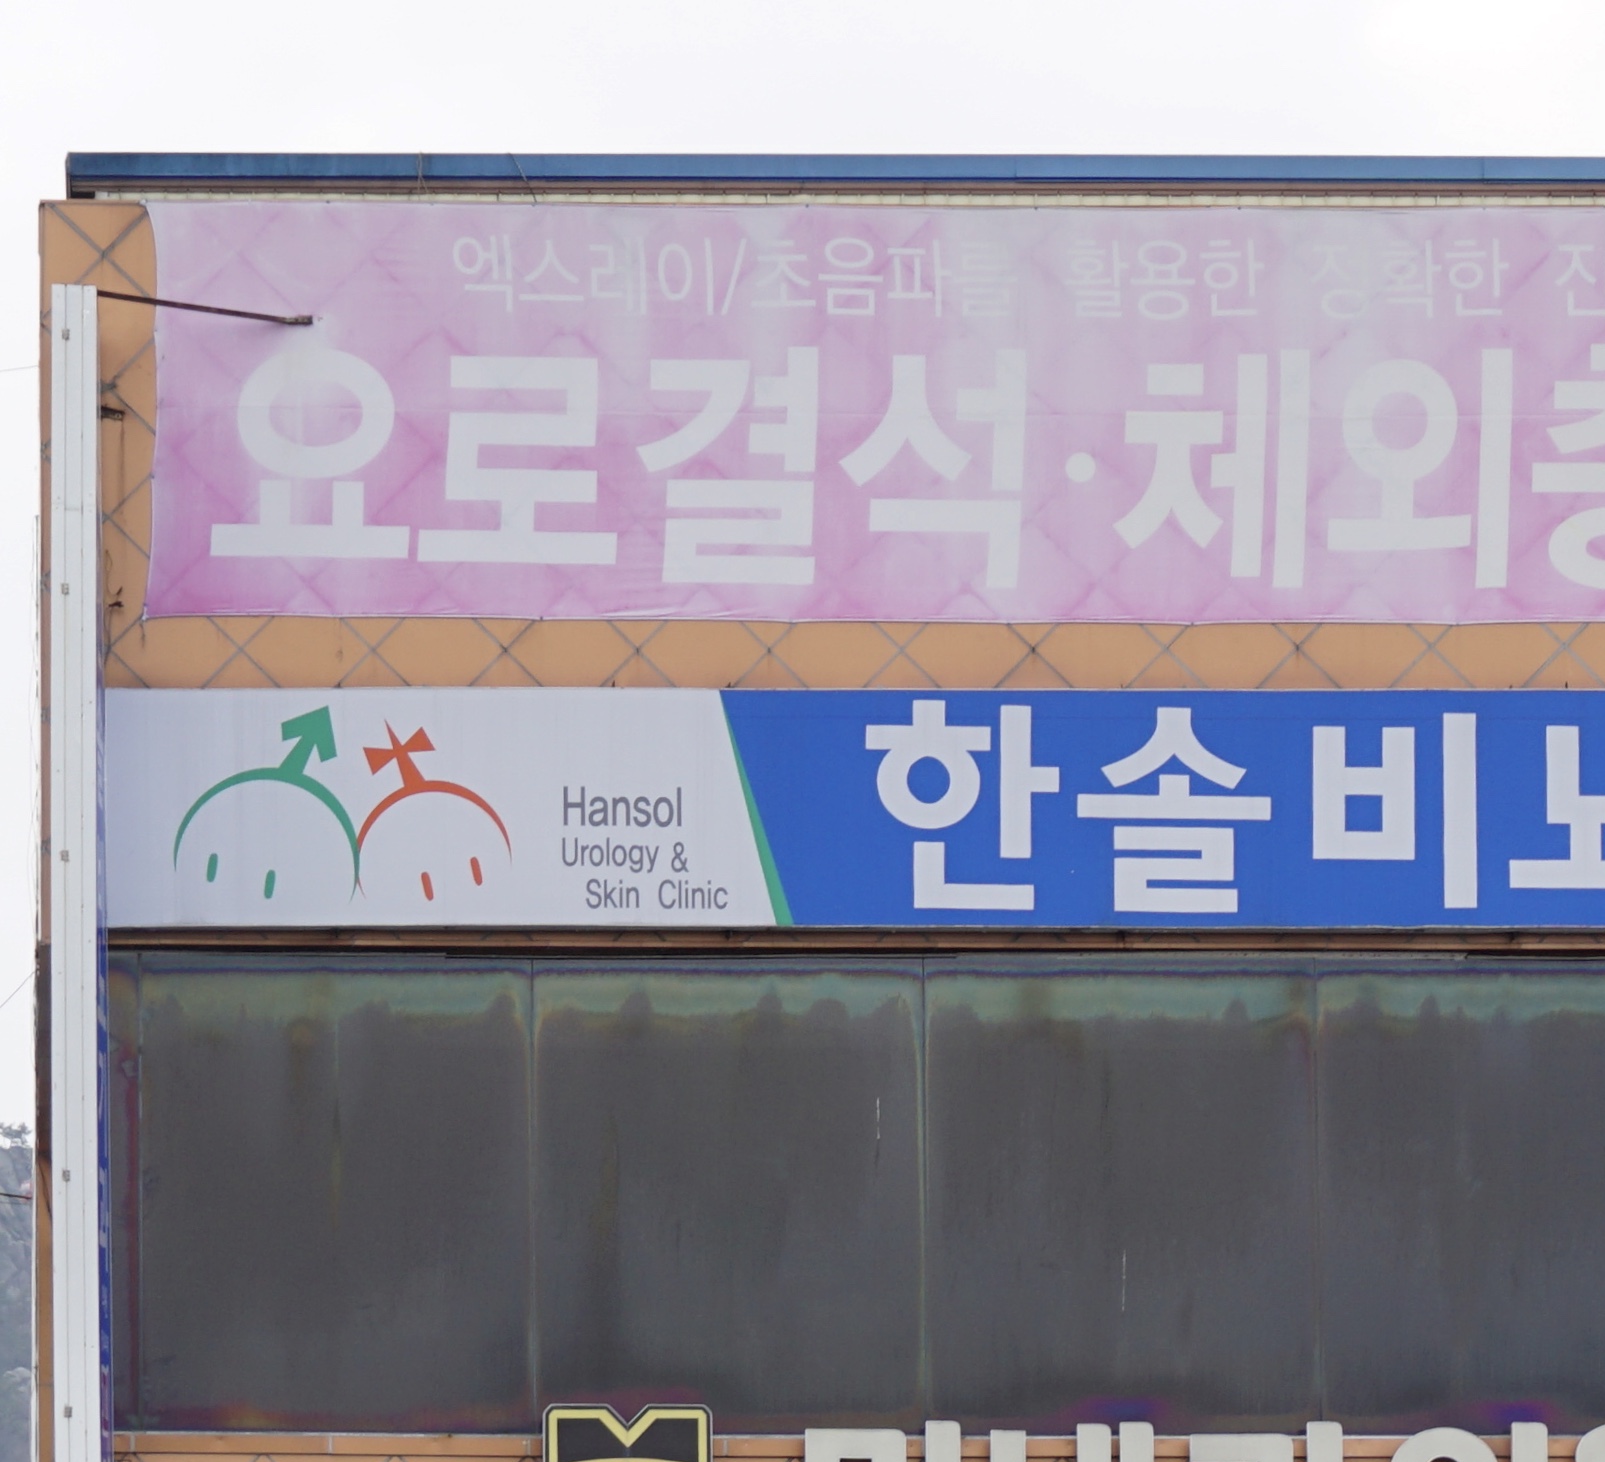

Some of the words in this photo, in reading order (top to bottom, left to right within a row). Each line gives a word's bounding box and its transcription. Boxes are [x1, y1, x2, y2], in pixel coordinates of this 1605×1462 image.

[1066, 237, 1265, 320] 활용한
[1308, 237, 1510, 320] 정확한
[562, 786, 683, 828] Hansol
[561, 838, 660, 875] Urology
[671, 842, 690, 873] &
[585, 880, 640, 910] Skin
[657, 880, 729, 911] Clinic
